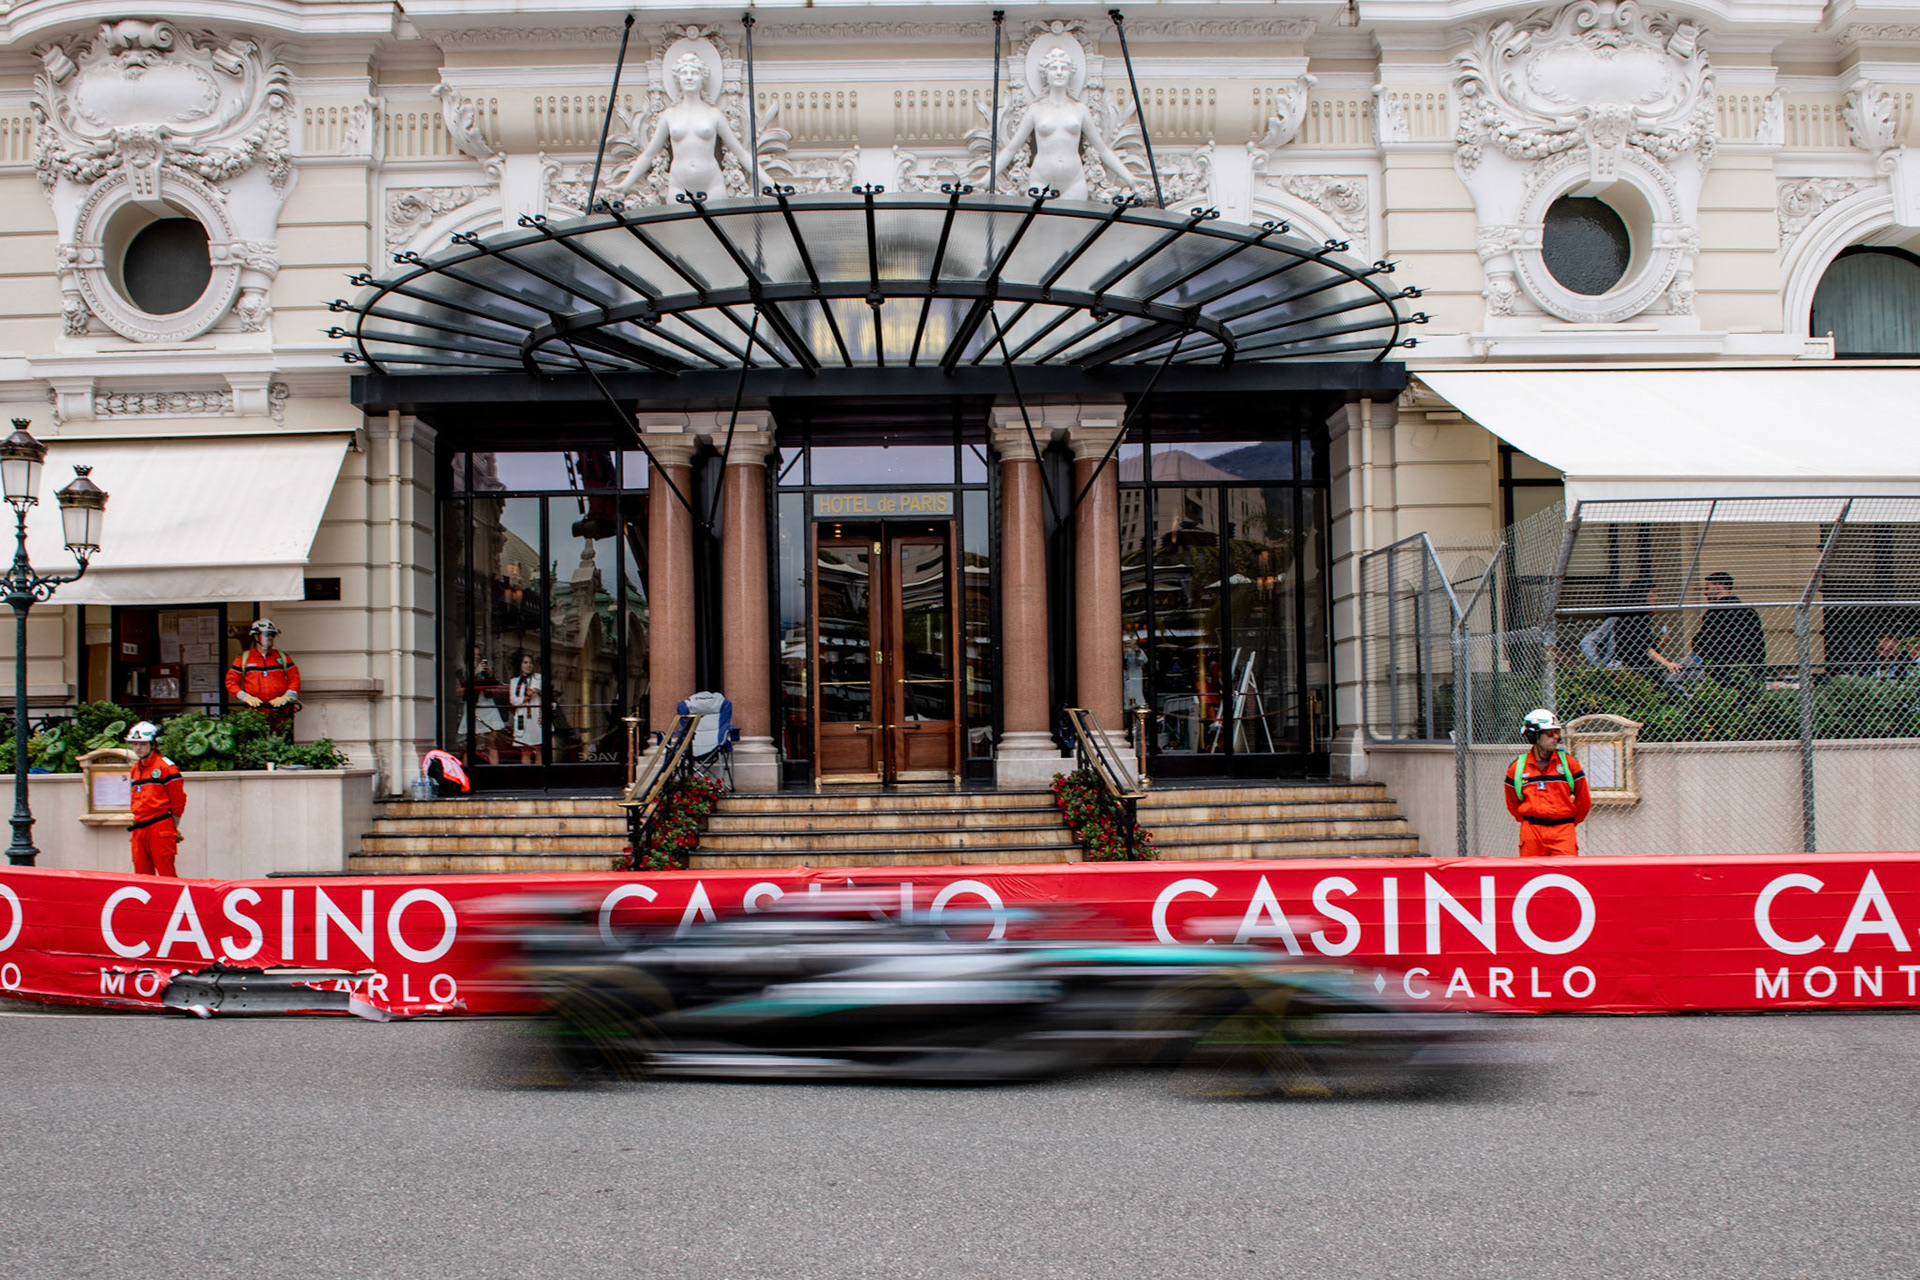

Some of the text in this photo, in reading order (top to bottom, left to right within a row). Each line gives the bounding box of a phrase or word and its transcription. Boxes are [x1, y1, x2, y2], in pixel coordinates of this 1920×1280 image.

[819, 494, 948, 514] HOTEL de PARIS
[101, 885, 457, 963] CASINO
[1152, 872, 1596, 956] CASINO
[1403, 966, 1596, 999] CARLO
